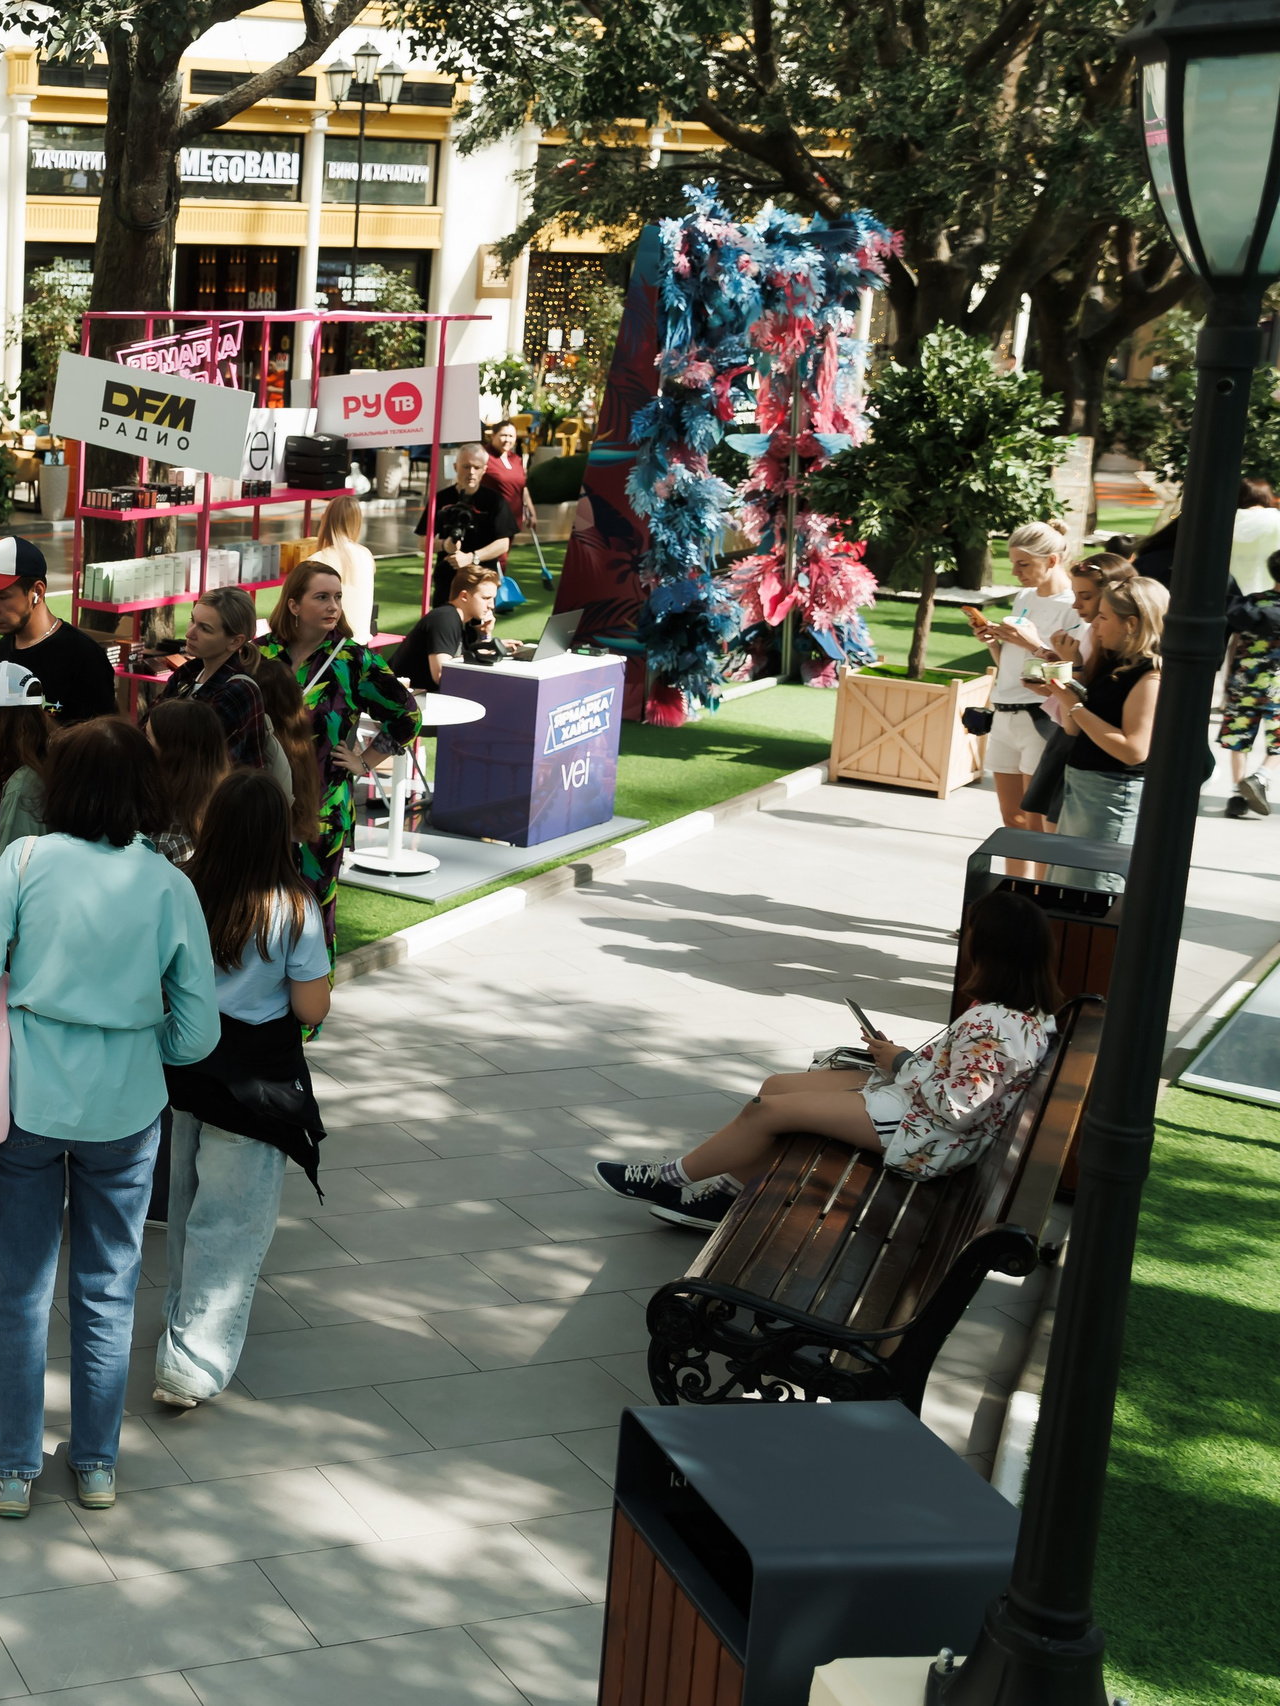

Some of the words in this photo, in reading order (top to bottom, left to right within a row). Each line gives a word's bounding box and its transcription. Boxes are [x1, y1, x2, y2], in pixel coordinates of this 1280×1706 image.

[34, 150, 101, 171] ХАЧАПУРИ
[180, 148, 299, 184] MEGOBARI
[328, 162, 359, 182] ВИНО
[373, 163, 430, 184] ХАЧАПУРИ
[248, 291, 277, 310] BARI
[102, 380, 196, 432] DFM
[99, 417, 190, 451] РАДИО
[343, 429, 389, 438] МУЗЫКАЛЬНЫЙ
[389, 427, 424, 436] ТЕЛЕКАНАЛ
[553, 696, 610, 729] ЯРМАРКА
[561, 714, 602, 741] ХАЙПА
[561, 751, 590, 791] vei
